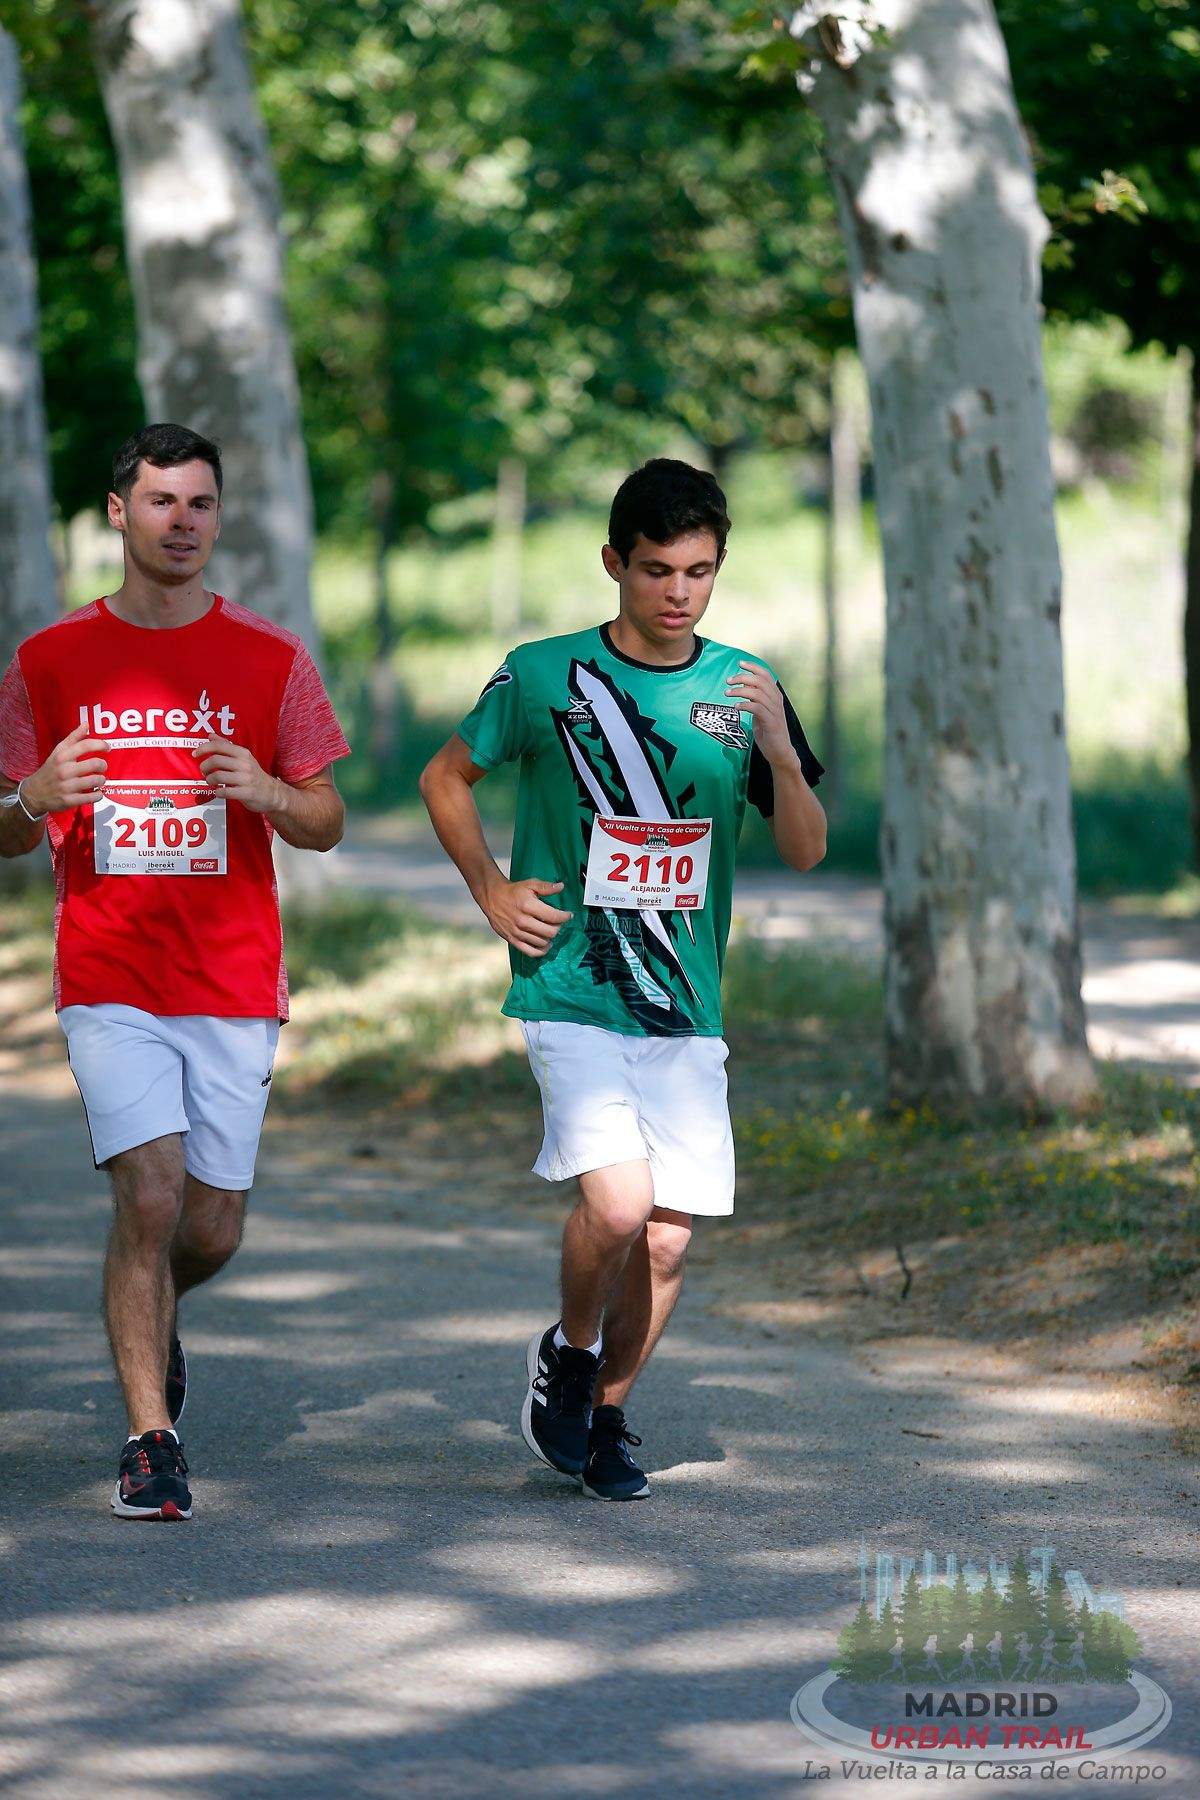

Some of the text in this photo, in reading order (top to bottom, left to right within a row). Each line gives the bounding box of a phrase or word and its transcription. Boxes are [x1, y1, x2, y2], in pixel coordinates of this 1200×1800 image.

[79, 703, 235, 736] Iberext
[697, 711, 738, 721] RIVAS
[144, 738, 178, 746] Contra
[114, 817, 207, 848] 2109
[616, 823, 639, 832] Vuelta
[675, 826, 684, 834] de
[684, 827, 707, 835] Campo
[607, 852, 694, 885] 2110
[630, 885, 671, 893] ALEJANDRO
